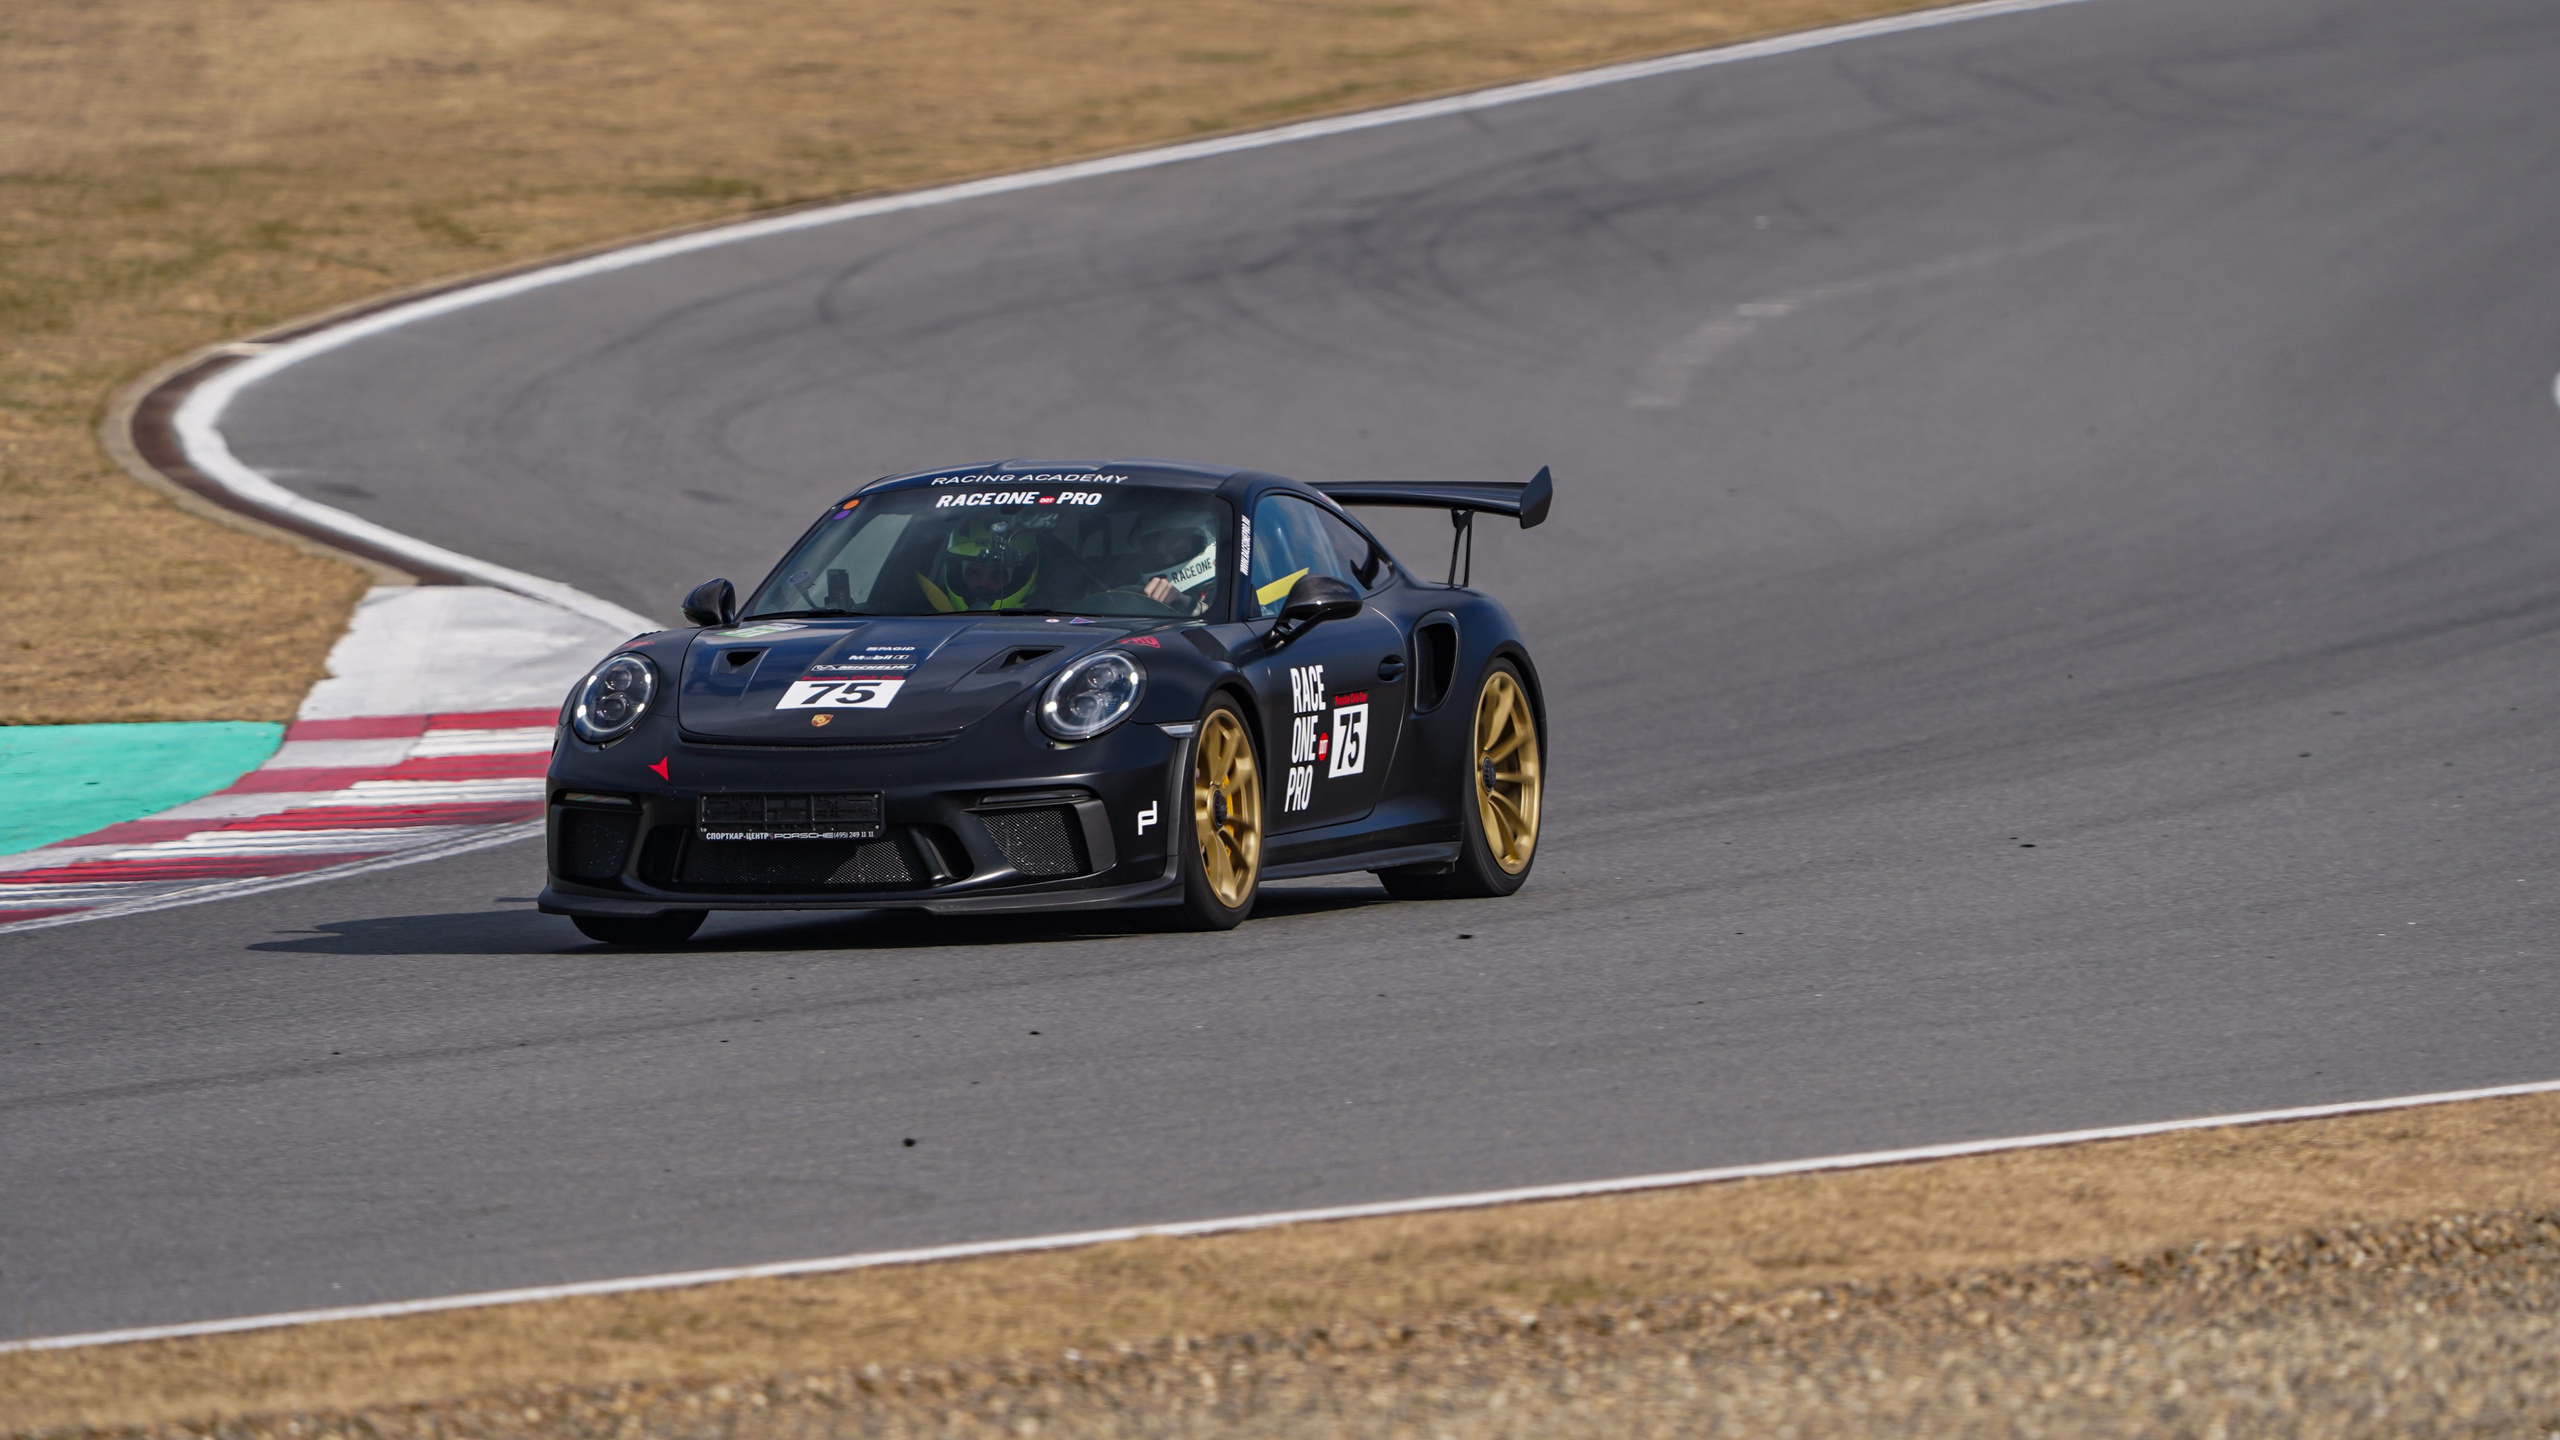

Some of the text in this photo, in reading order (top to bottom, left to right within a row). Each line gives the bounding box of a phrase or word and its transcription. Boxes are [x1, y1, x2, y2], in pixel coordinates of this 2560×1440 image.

[930, 473, 1129, 486] RACING ACADEMY
[935, 491, 1040, 508] RACEONE
[1055, 491, 1103, 507] PRO
[800, 682, 882, 705] 75
[1289, 664, 1327, 714] RACE
[1291, 714, 1318, 764] ONE
[1336, 711, 1362, 771] 75
[1284, 764, 1314, 813] PRO
[705, 832, 769, 841] СПОРТКАР-ЦЕНТР
